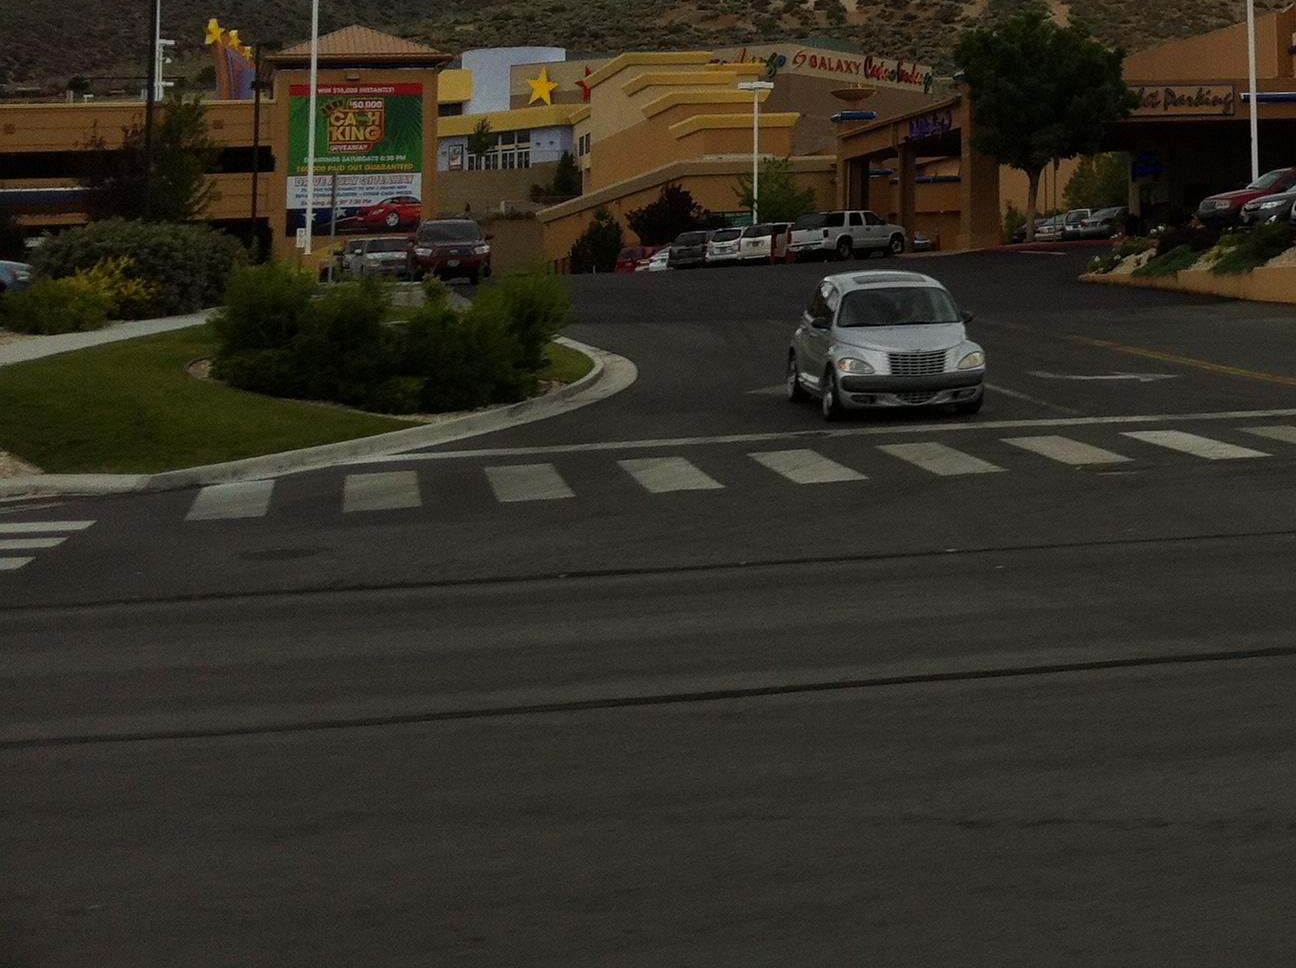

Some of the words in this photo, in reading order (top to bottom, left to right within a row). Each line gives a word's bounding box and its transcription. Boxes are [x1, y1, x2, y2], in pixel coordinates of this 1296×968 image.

[809, 54, 862, 75] GALAXY
[330, 111, 381, 126] CAH
[330, 126, 381, 141] KING
